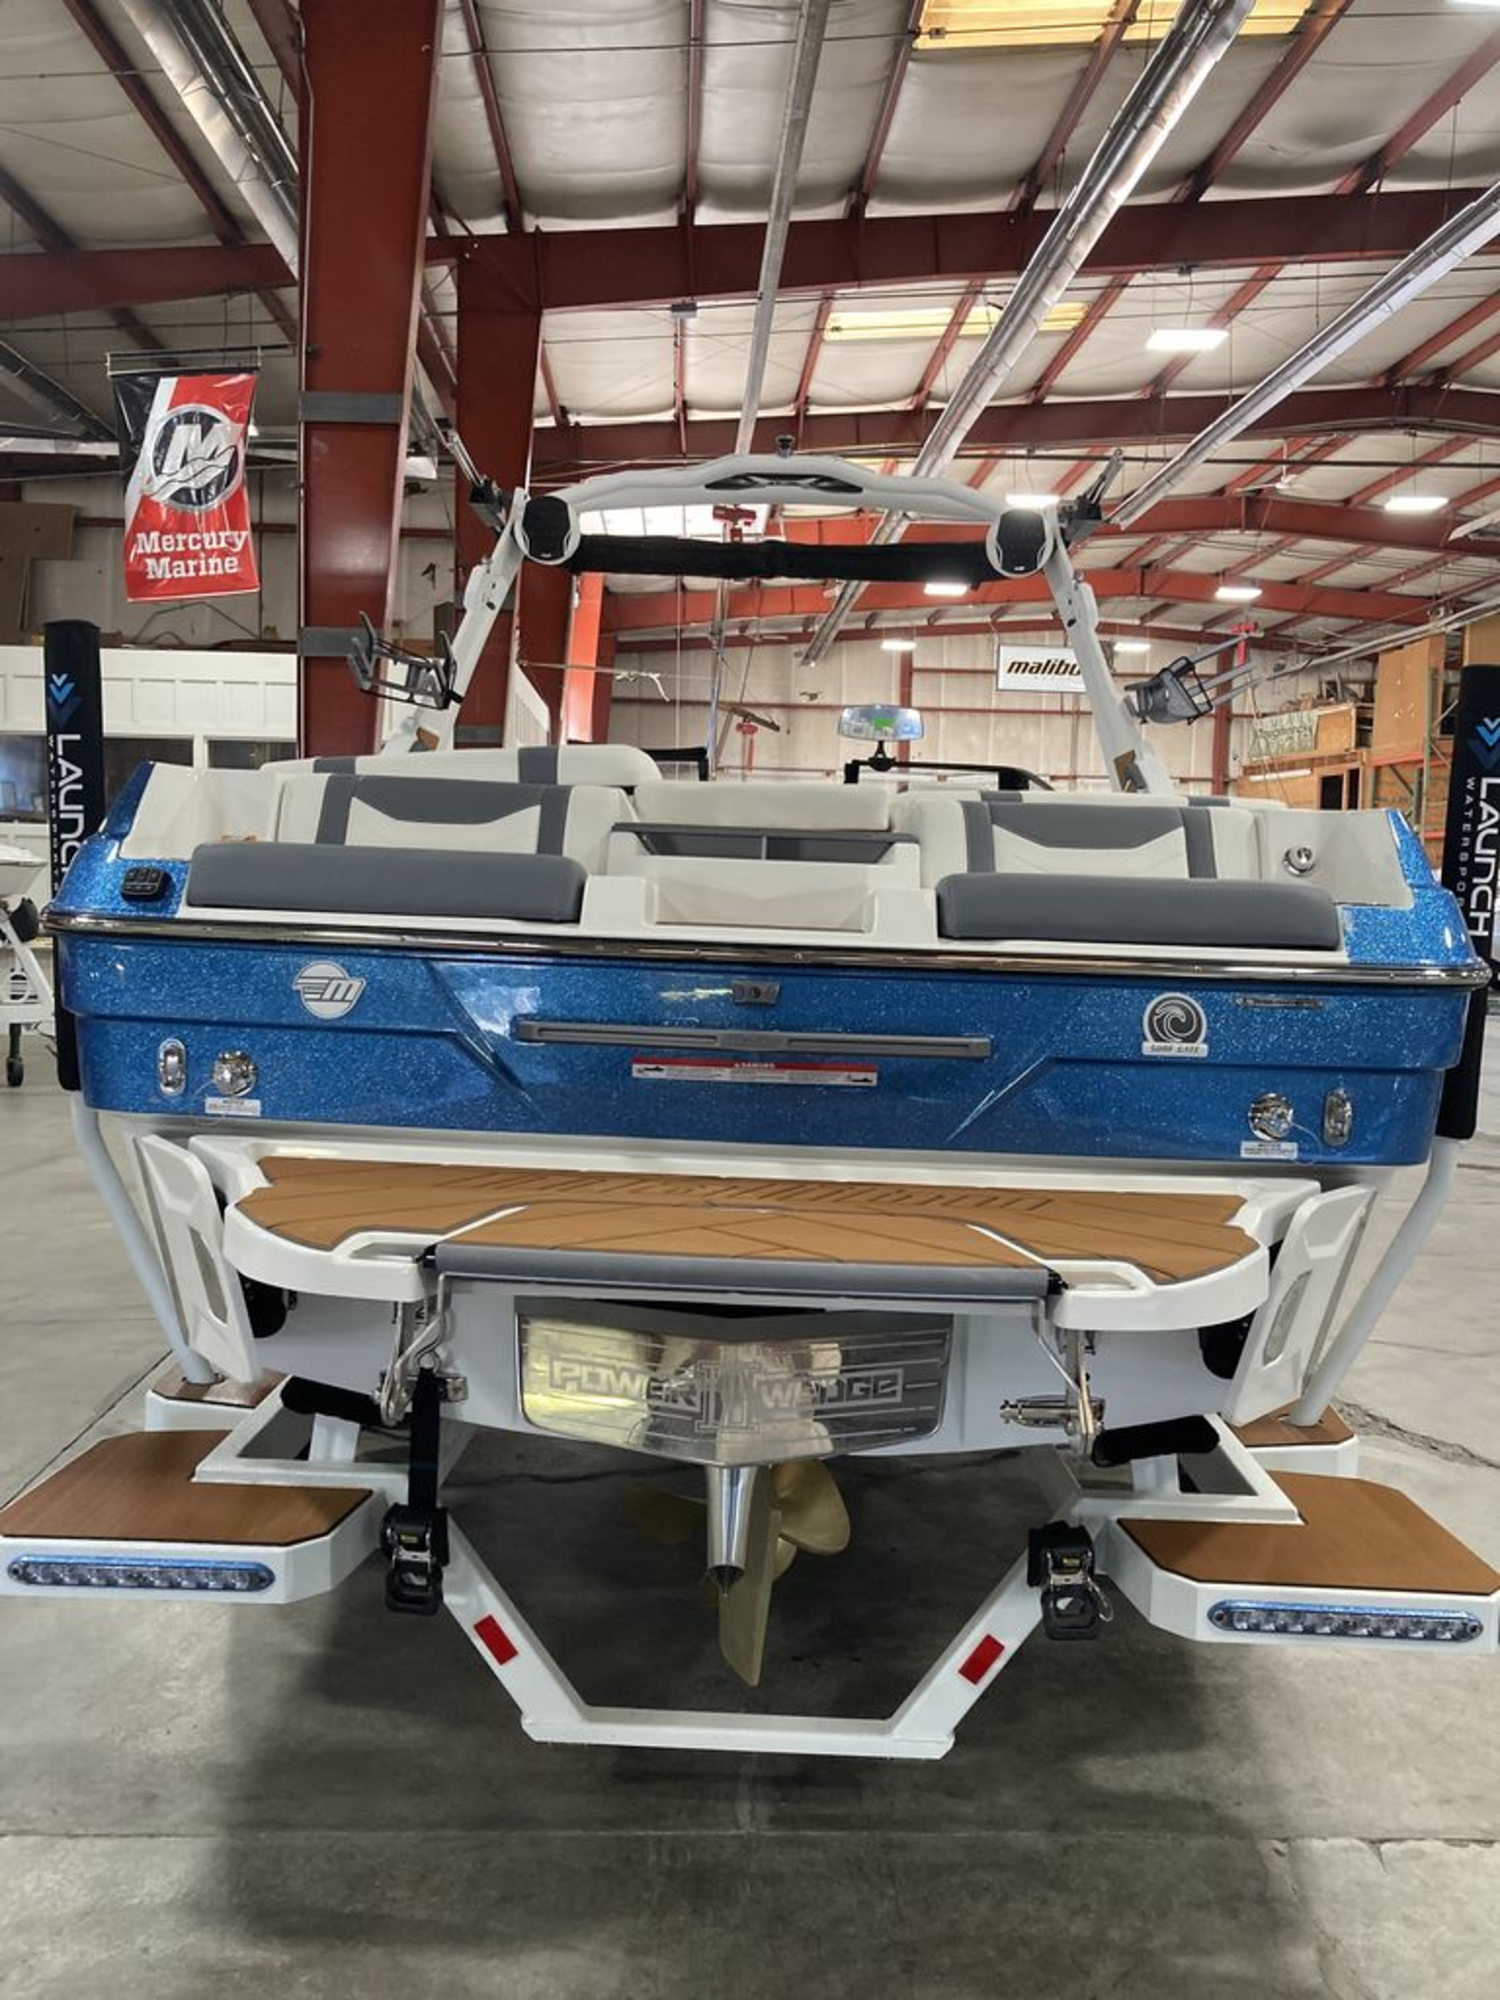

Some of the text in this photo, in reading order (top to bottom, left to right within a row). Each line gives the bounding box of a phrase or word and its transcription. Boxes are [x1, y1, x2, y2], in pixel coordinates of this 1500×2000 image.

[136, 531, 248, 554] Mercury
[146, 553, 238, 578] Marine
[1007, 659, 1081, 676] malibu
[57, 734, 84, 873] LAUNC
[553, 1364, 698, 1407] POWER
